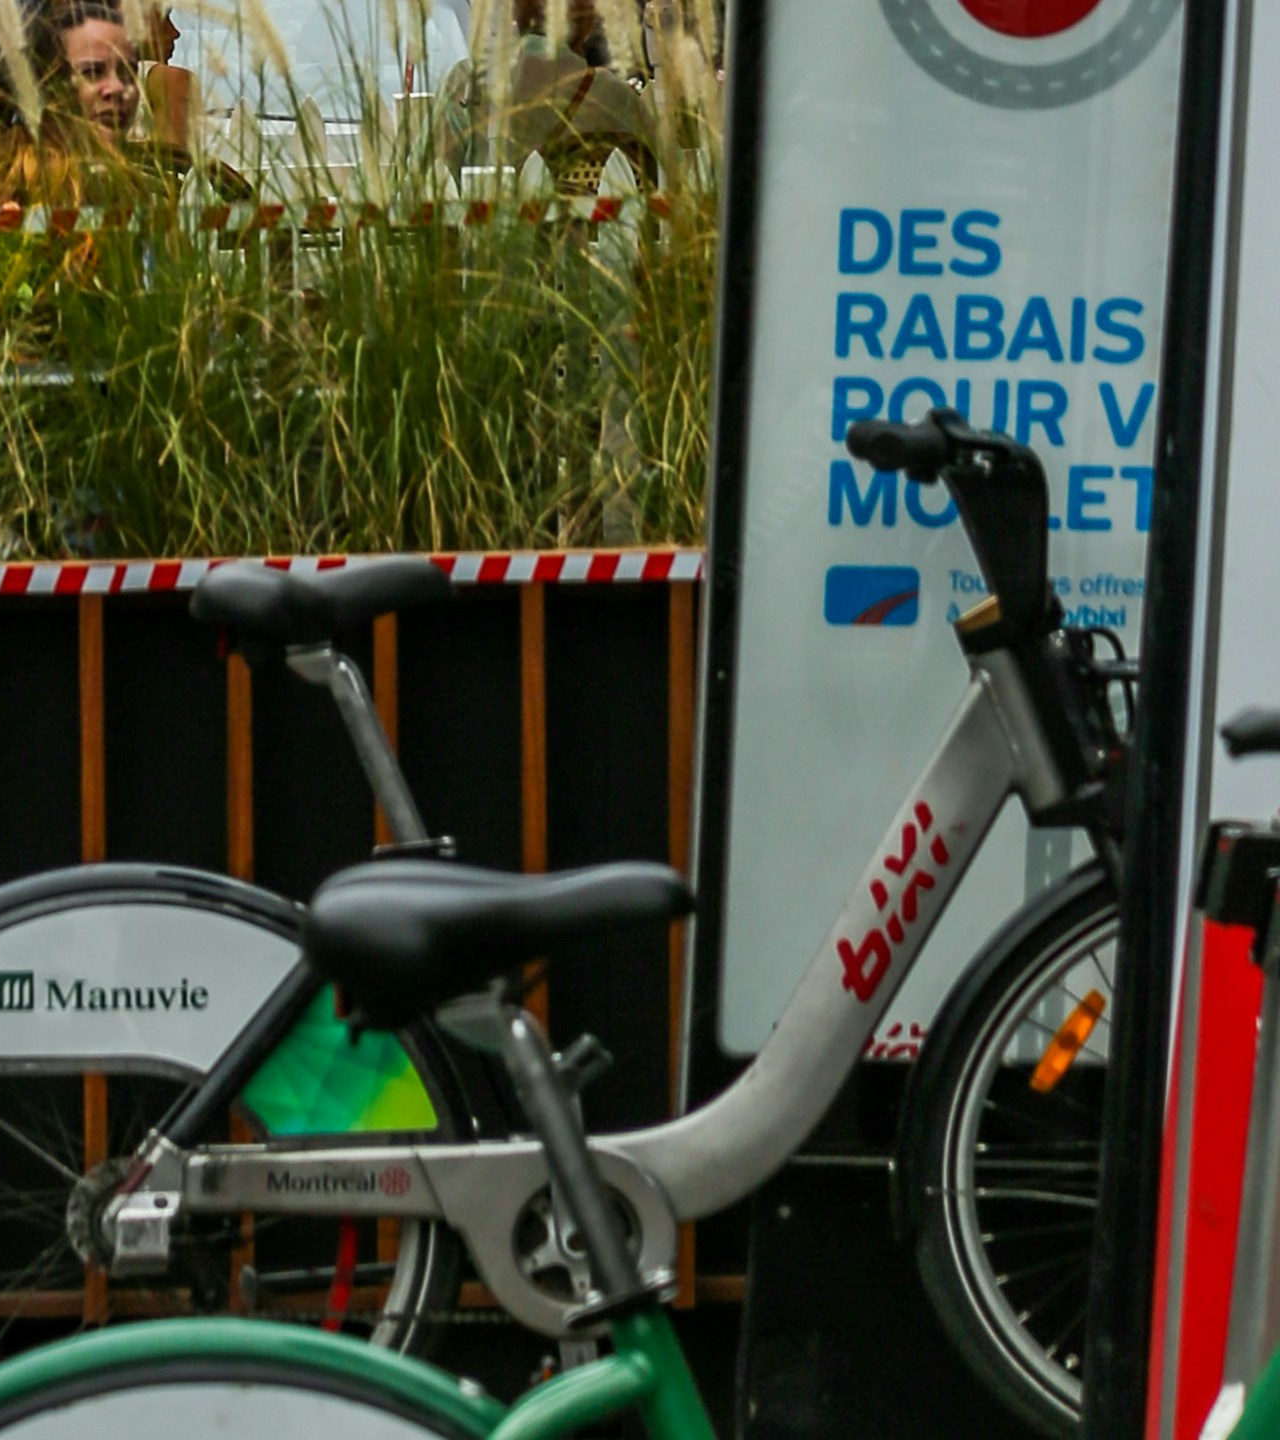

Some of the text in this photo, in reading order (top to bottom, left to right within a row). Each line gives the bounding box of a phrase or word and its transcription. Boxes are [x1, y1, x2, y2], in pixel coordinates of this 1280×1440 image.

[838, 208, 1003, 277] DES
[834, 292, 1145, 365] RABAIS
[827, 459, 1156, 532] MOET
[838, 800, 951, 1003] bixi
[45, 978, 209, 1012] Manuvie
